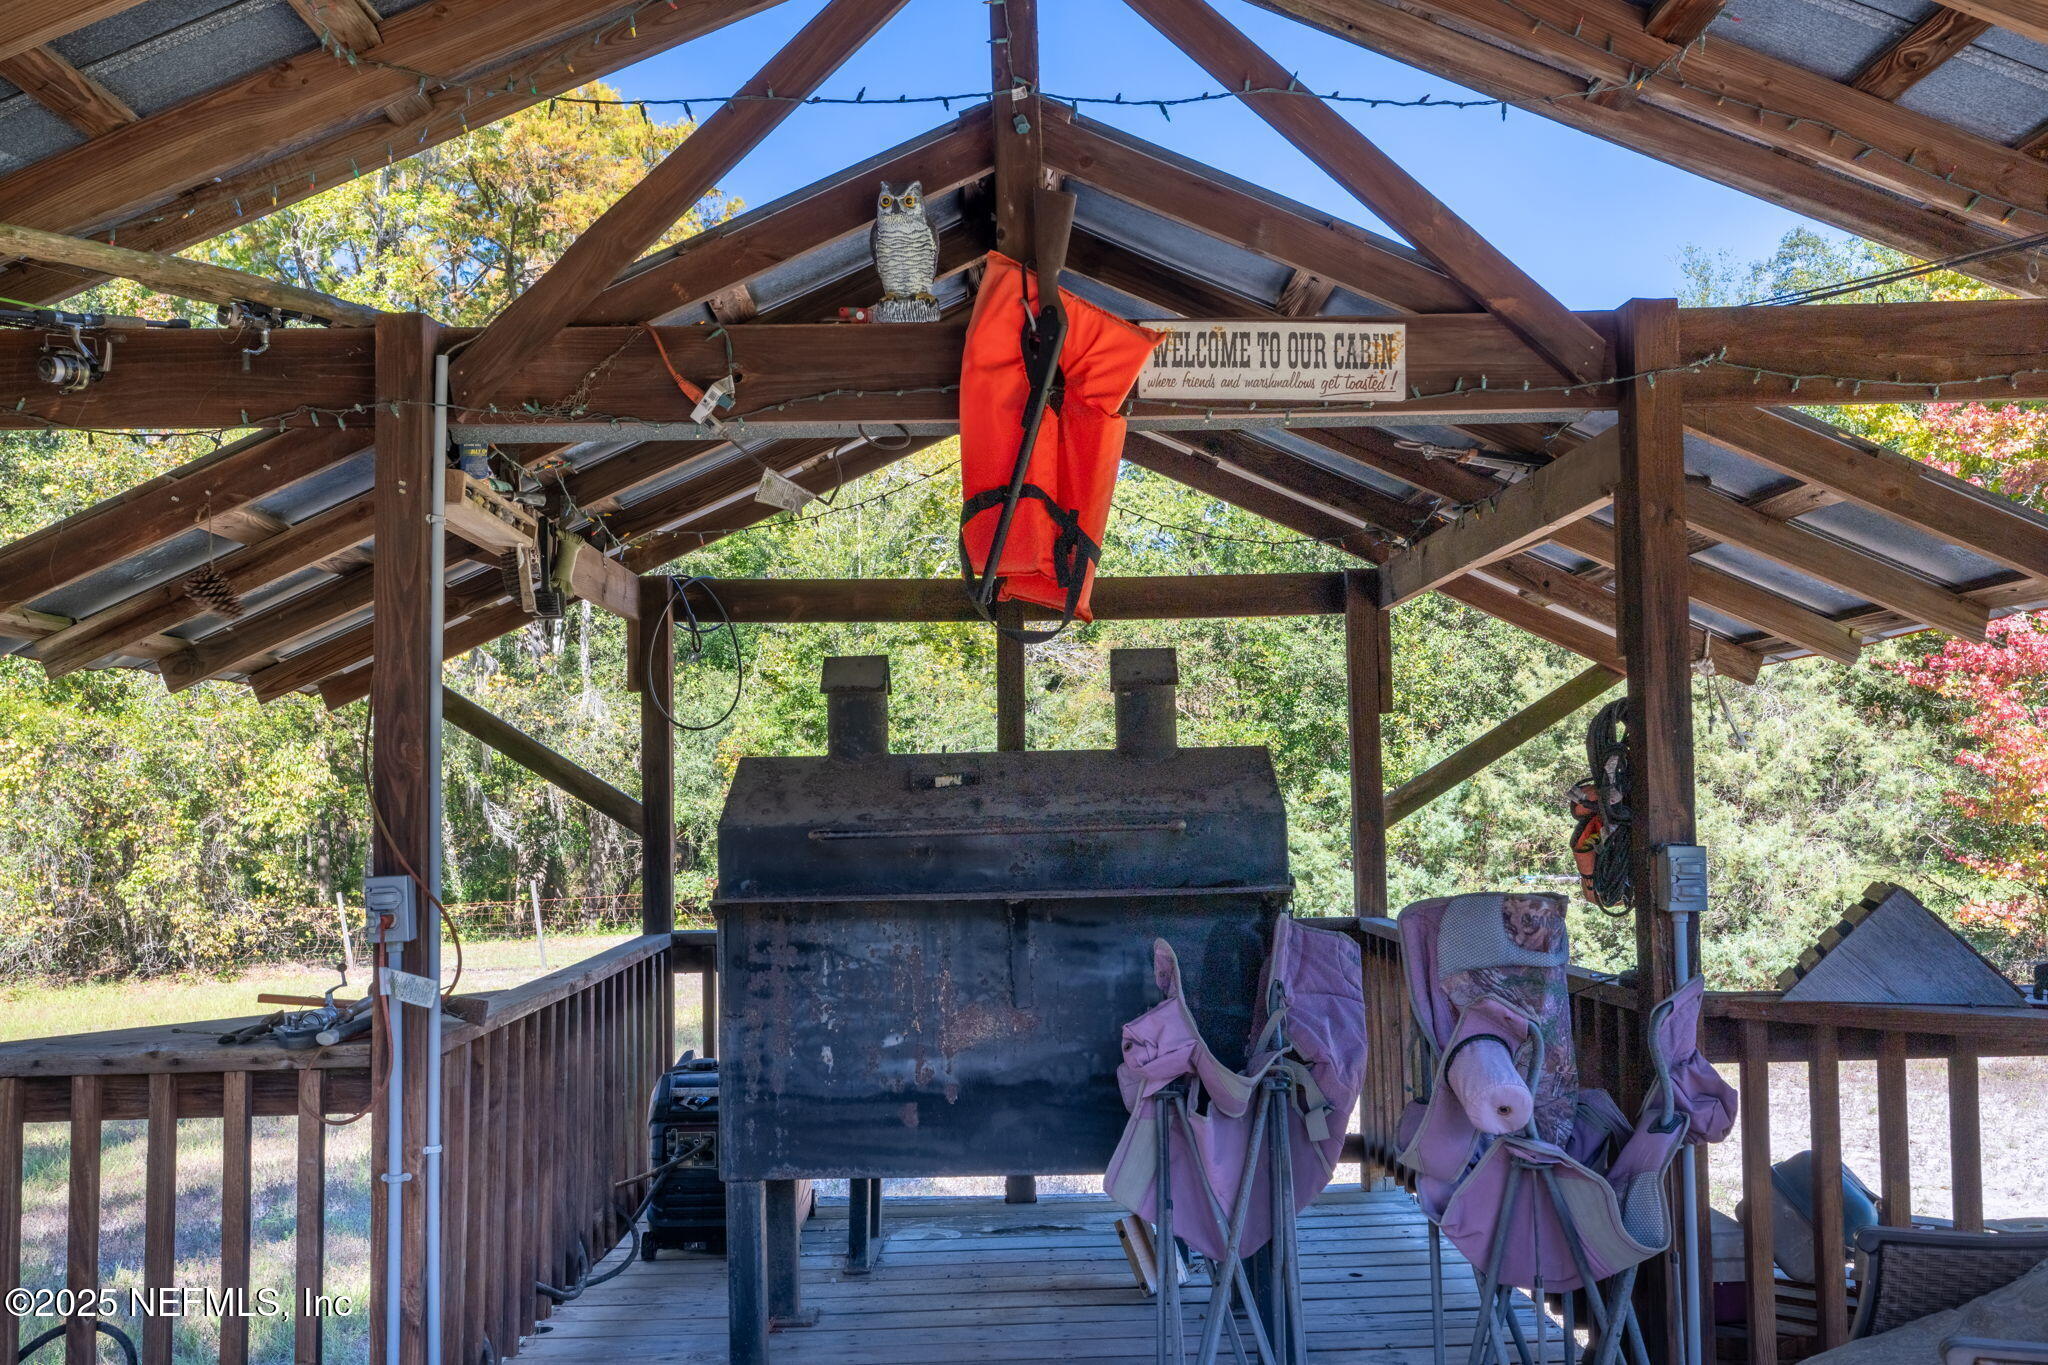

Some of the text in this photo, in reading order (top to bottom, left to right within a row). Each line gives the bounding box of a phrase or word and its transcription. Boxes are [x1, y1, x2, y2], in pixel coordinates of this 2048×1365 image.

[1153, 331, 1394, 370] WELCOME TO OUR CABIN
[1147, 372, 1177, 388] where
[1182, 370, 1216, 389] friends
[1220, 373, 1242, 388] and
[1244, 371, 1316, 389] marshmallows
[1320, 373, 1341, 395] get
